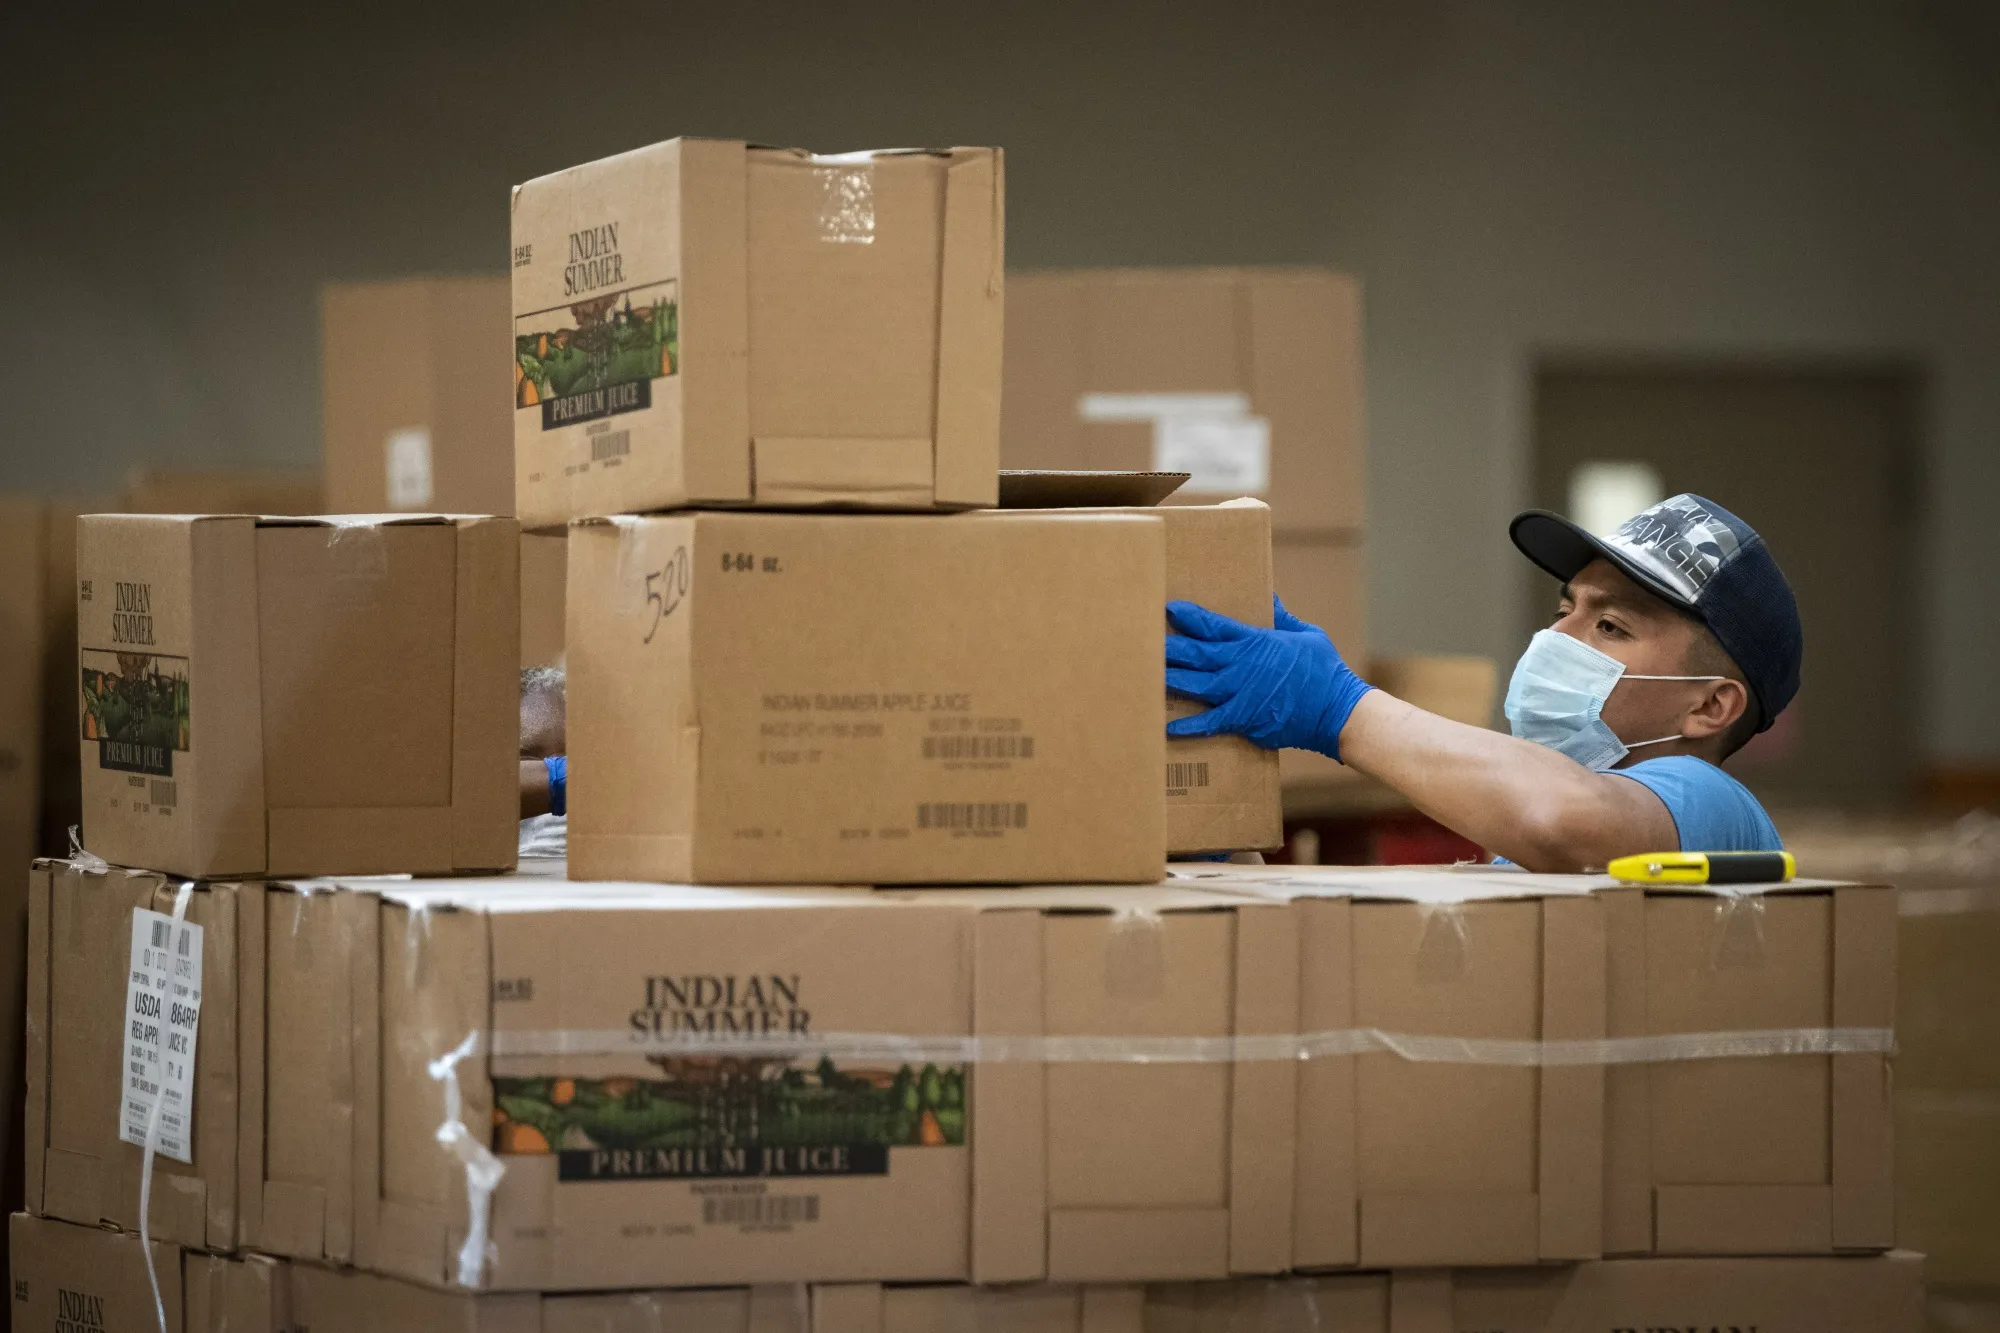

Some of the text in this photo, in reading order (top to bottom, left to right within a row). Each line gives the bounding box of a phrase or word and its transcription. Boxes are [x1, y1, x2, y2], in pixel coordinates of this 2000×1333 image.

[568, 221, 618, 264] INDIAN
[564, 254, 624, 296] SUMMER
[552, 382, 638, 422] PREMIUM JUICE
[721, 552, 754, 572] 8-64
[115, 582, 152, 613] INDIAN
[643, 545, 689, 645] 520
[112, 613, 155, 646] SUMMER
[106, 741, 164, 771] PREMIUM JUICE
[134, 991, 160, 1019] USDA
[643, 974, 801, 1009] INDIAN
[131, 1020, 143, 1040] REG
[628, 1008, 812, 1043] SUMMER
[592, 1145, 852, 1176] PREMIUM JUICE
[58, 1289, 104, 1325] INDIAN
